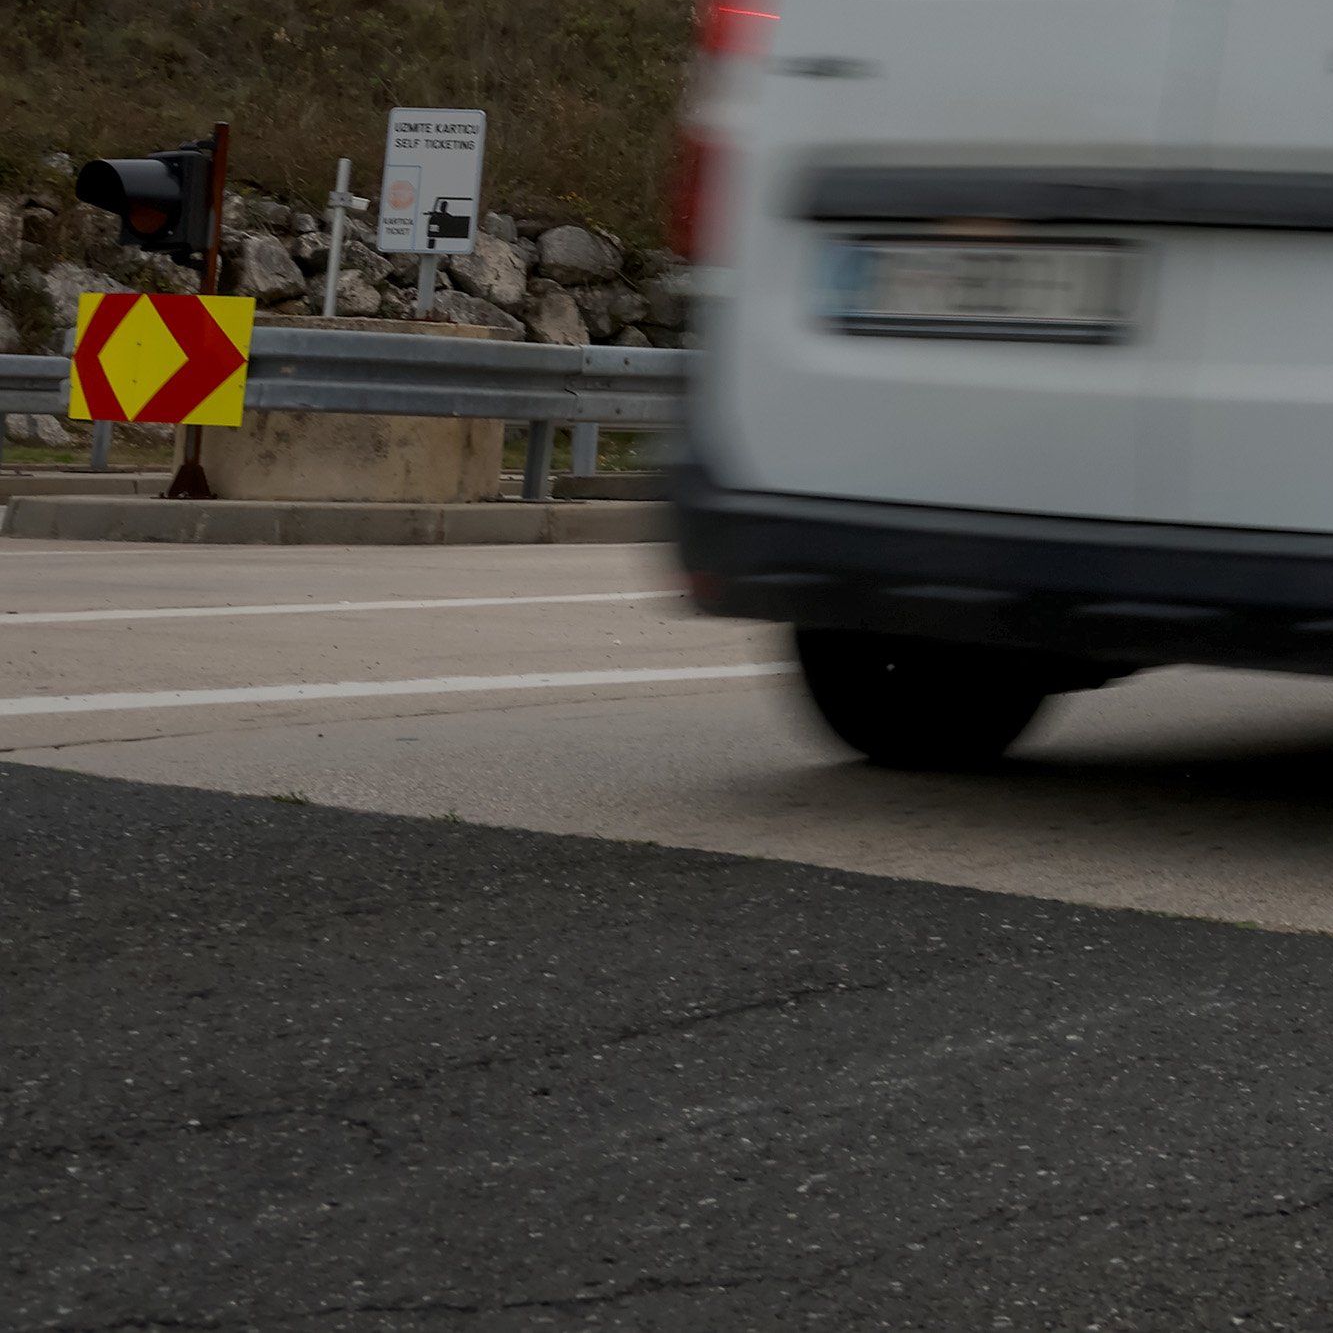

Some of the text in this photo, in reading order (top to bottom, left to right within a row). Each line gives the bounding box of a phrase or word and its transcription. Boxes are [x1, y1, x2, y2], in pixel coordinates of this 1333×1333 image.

[394, 122, 479, 135] UZMITE KARTICU
[394, 138, 476, 151] SELF TICKETING
